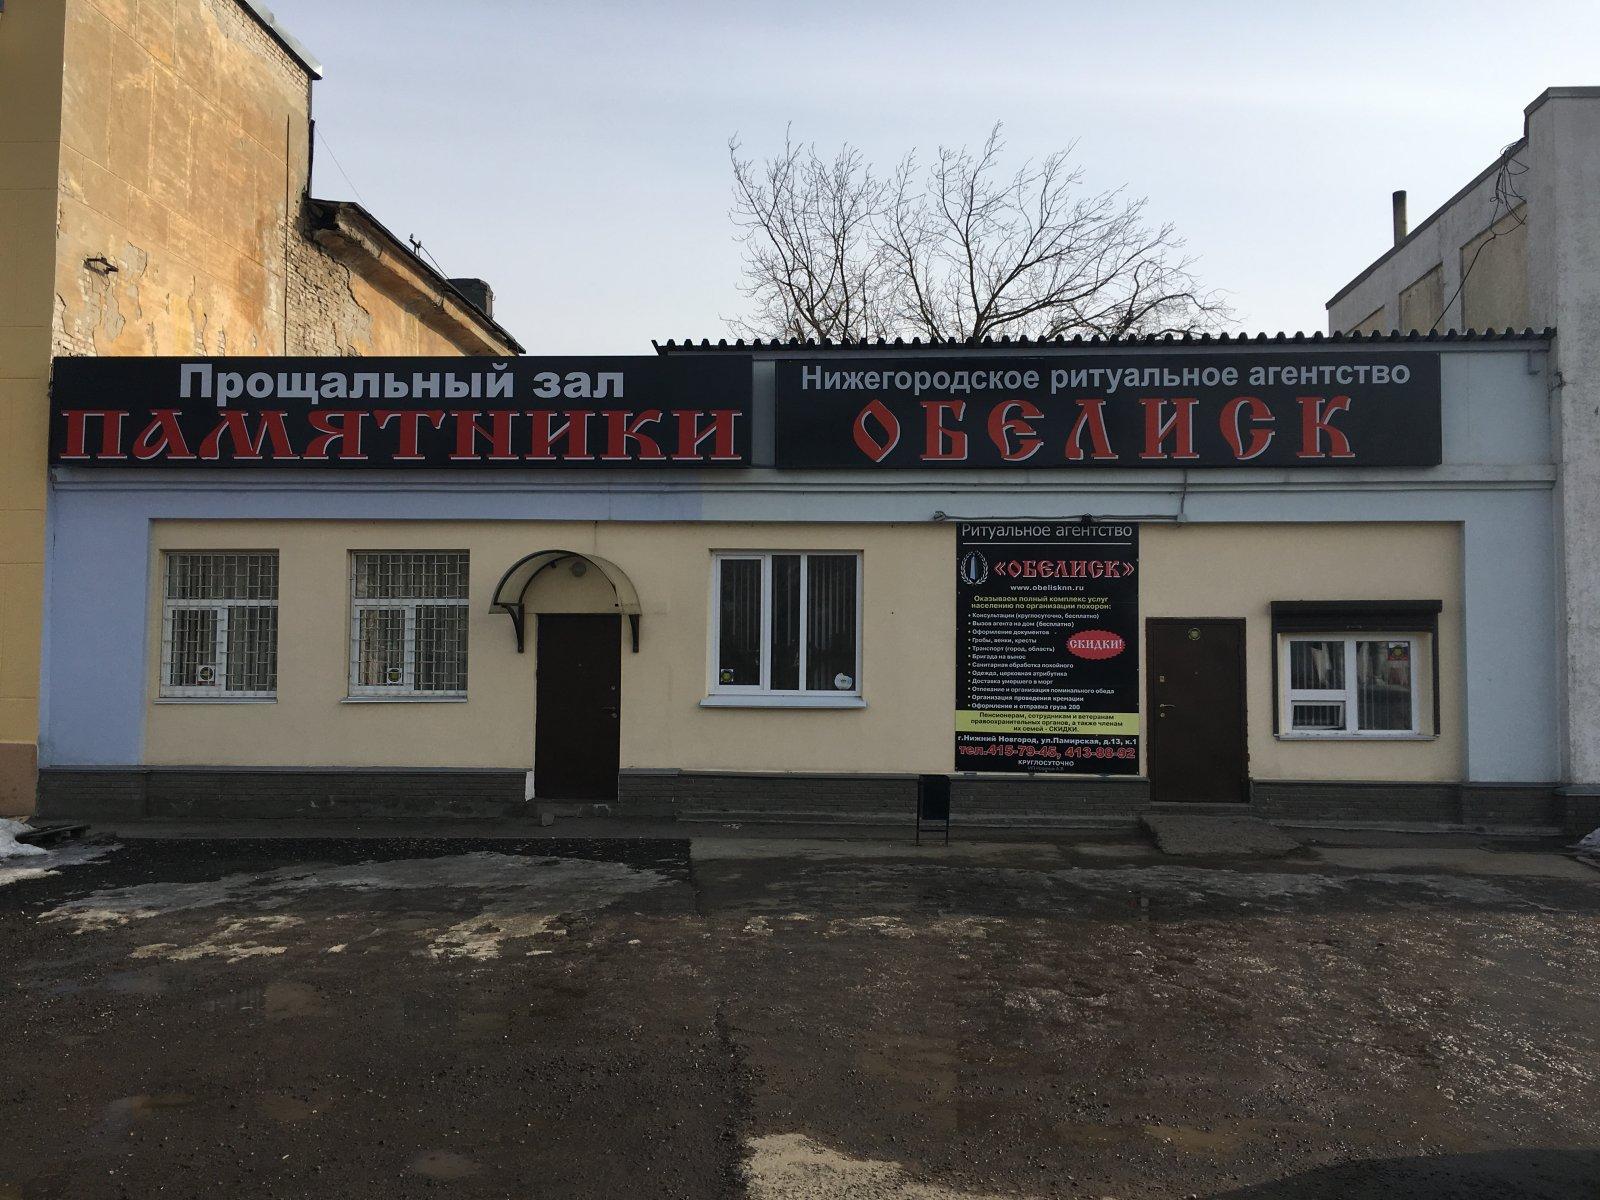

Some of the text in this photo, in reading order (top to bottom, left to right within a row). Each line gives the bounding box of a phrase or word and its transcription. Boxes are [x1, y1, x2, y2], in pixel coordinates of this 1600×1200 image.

[179, 362, 625, 406] Прощальный зал
[802, 361, 1411, 396] Нижегородское ритуальное агентство
[60, 409, 743, 461] ПАМЯТНИКИ
[852, 395, 1356, 462] ОБЕЛИСК
[962, 524, 1132, 539] Ритуальное агентство
[993, 560, 1135, 578] «ОБЕЛИСК»
[1070, 640, 1122, 650] СКИДКИ!
[999, 736, 1038, 744] Новгород,
[959, 745, 1135, 759] тел.415-79-45, 413-88-92
